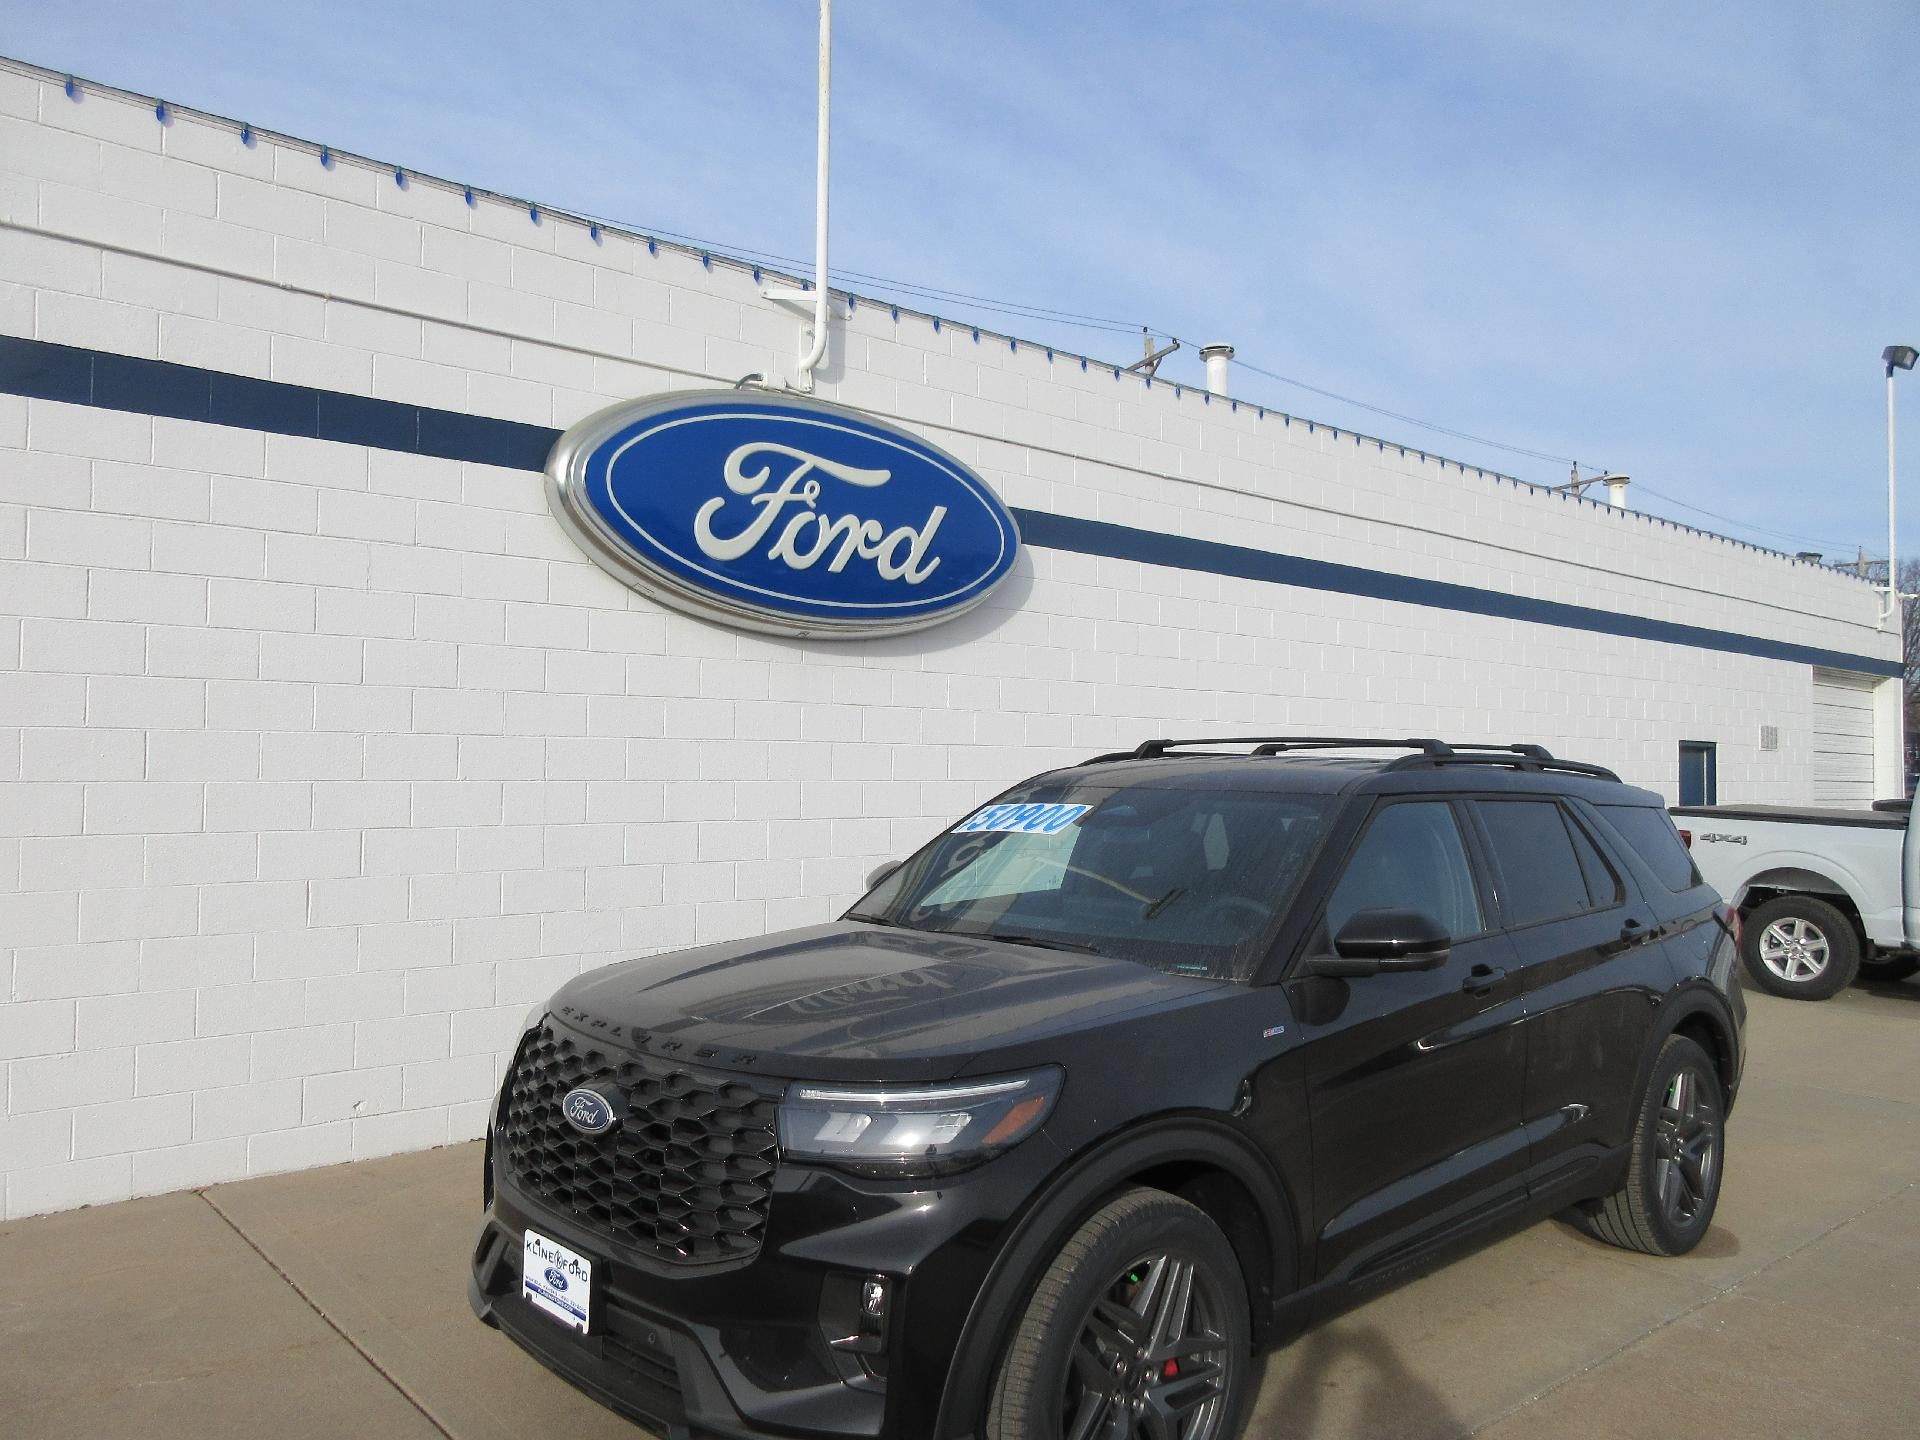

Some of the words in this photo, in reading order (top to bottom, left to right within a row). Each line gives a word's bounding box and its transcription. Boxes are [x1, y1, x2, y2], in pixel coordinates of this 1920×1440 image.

[694, 442, 948, 585] Ford
[570, 1096, 600, 1125] Ford
[526, 1240, 554, 1264] KLINE
[562, 1259, 588, 1282] FORD
[549, 1270, 565, 1288] Ford
